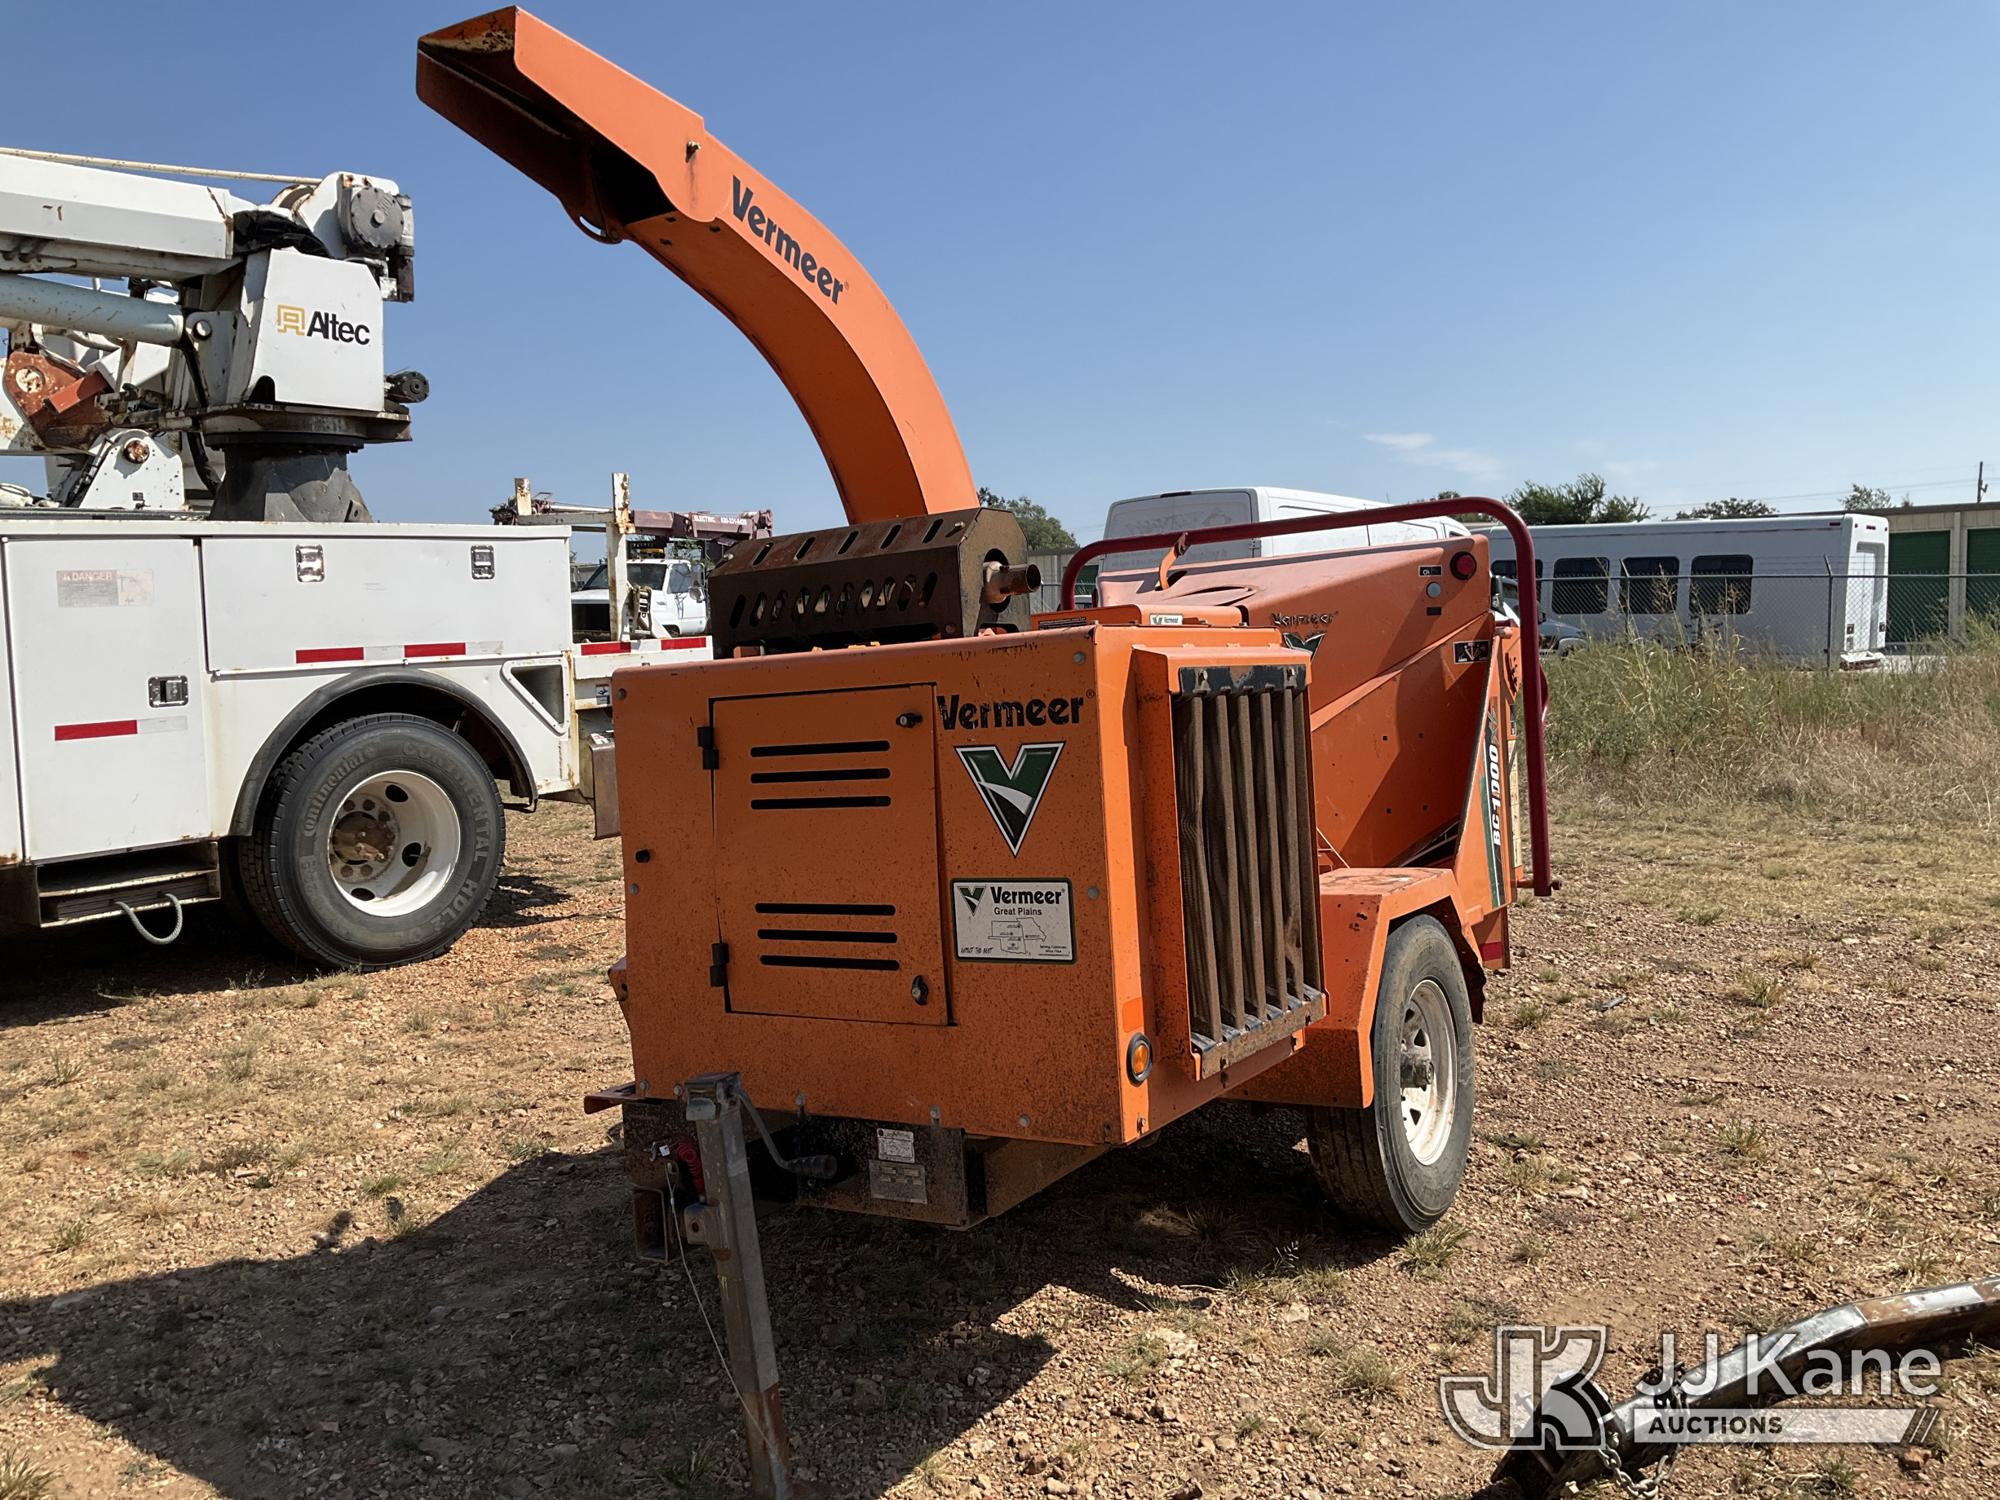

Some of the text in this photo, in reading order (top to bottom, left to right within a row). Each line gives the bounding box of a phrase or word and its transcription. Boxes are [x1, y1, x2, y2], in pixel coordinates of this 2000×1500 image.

[732, 174, 844, 305] Vermeer
[306, 310, 370, 345] Altec
[72, 571, 113, 581] DANGER
[936, 694, 1084, 731] Vermeer
[990, 886, 1062, 905] Vermeer
[994, 907, 1042, 916] Great Plains
